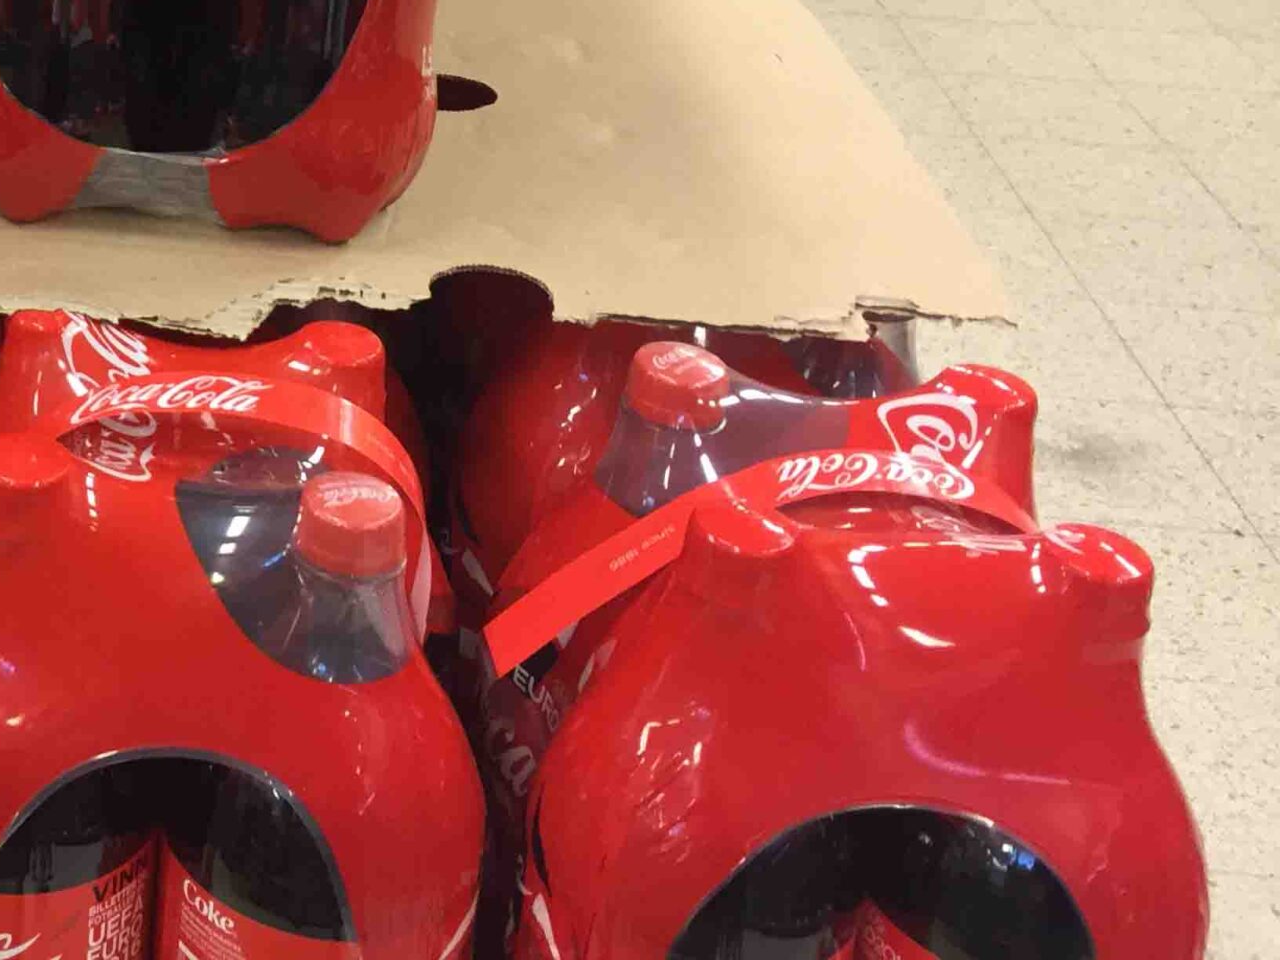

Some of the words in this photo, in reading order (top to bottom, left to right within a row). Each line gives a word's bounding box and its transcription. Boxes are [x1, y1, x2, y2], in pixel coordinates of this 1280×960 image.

[776, 452, 976, 502] Coca-Cola
[87, 901, 143, 947] UEFA
[183, 878, 235, 934] Coke
